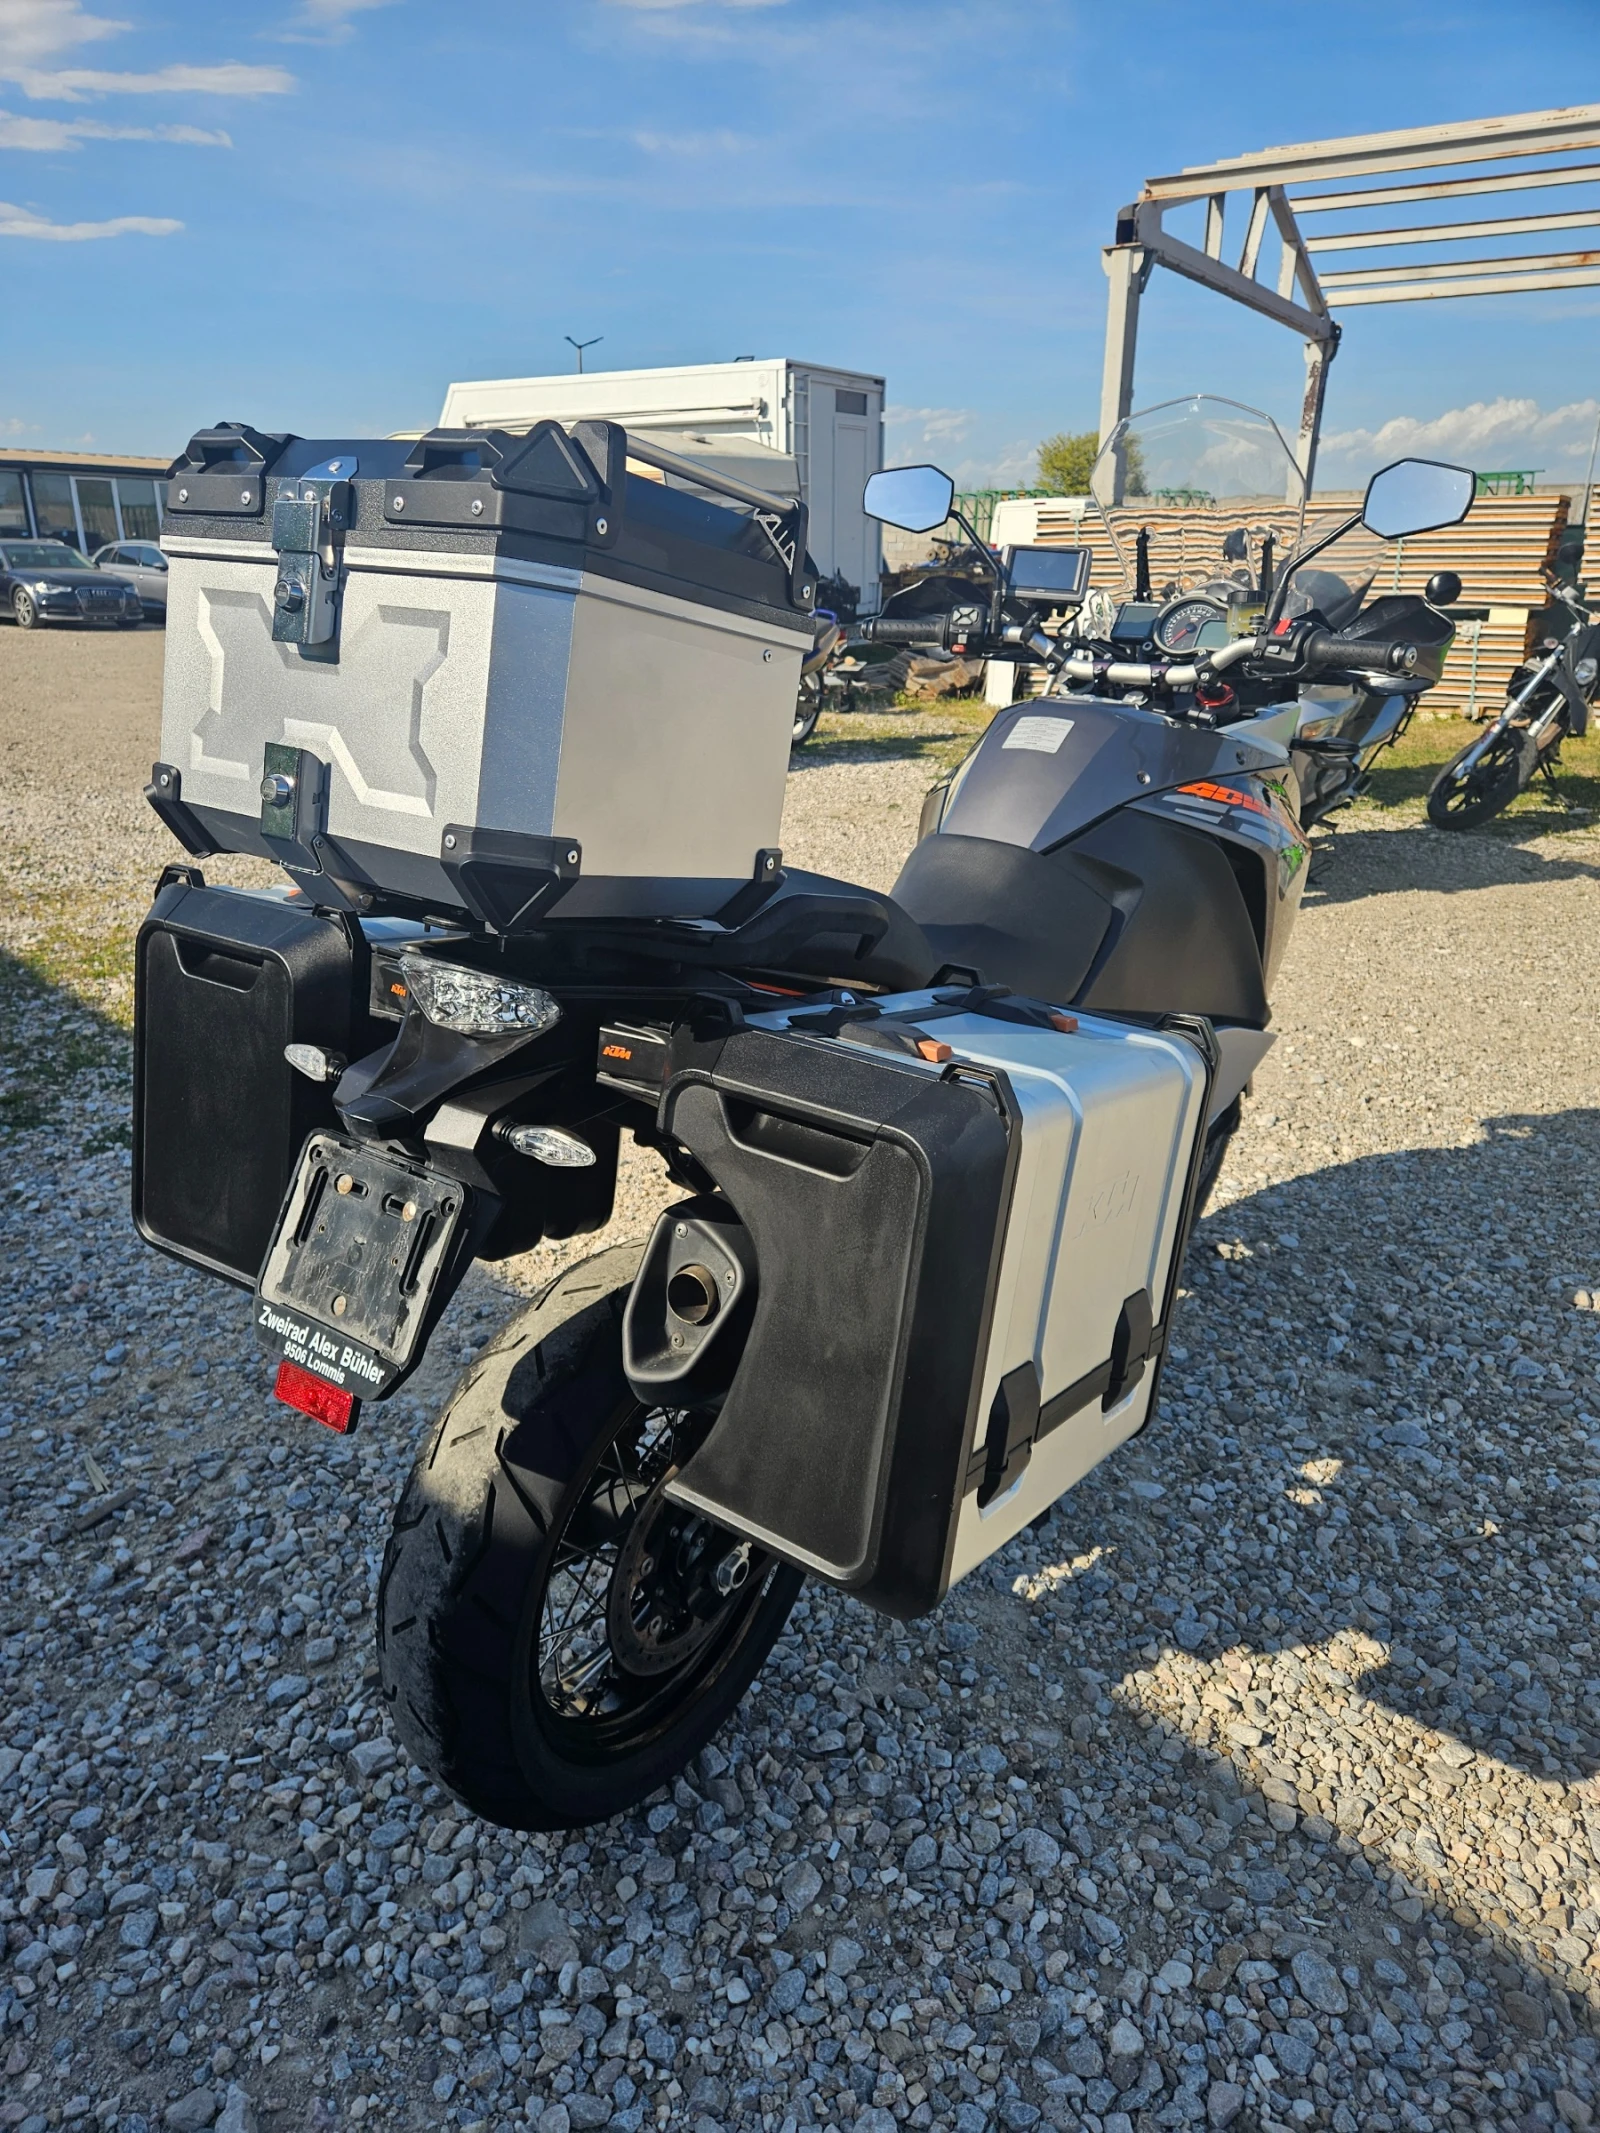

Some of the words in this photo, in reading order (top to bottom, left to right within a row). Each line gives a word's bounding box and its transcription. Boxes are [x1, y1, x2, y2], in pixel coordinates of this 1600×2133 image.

[390, 983, 406, 997] KTM
[603, 1045, 632, 1060] KTM
[258, 1304, 310, 1346] Zweirad
[308, 1331, 340, 1362] Alex
[339, 1346, 386, 1385] Bühler
[283, 1340, 308, 1364] 9506
[306, 1352, 346, 1385] Lommis
